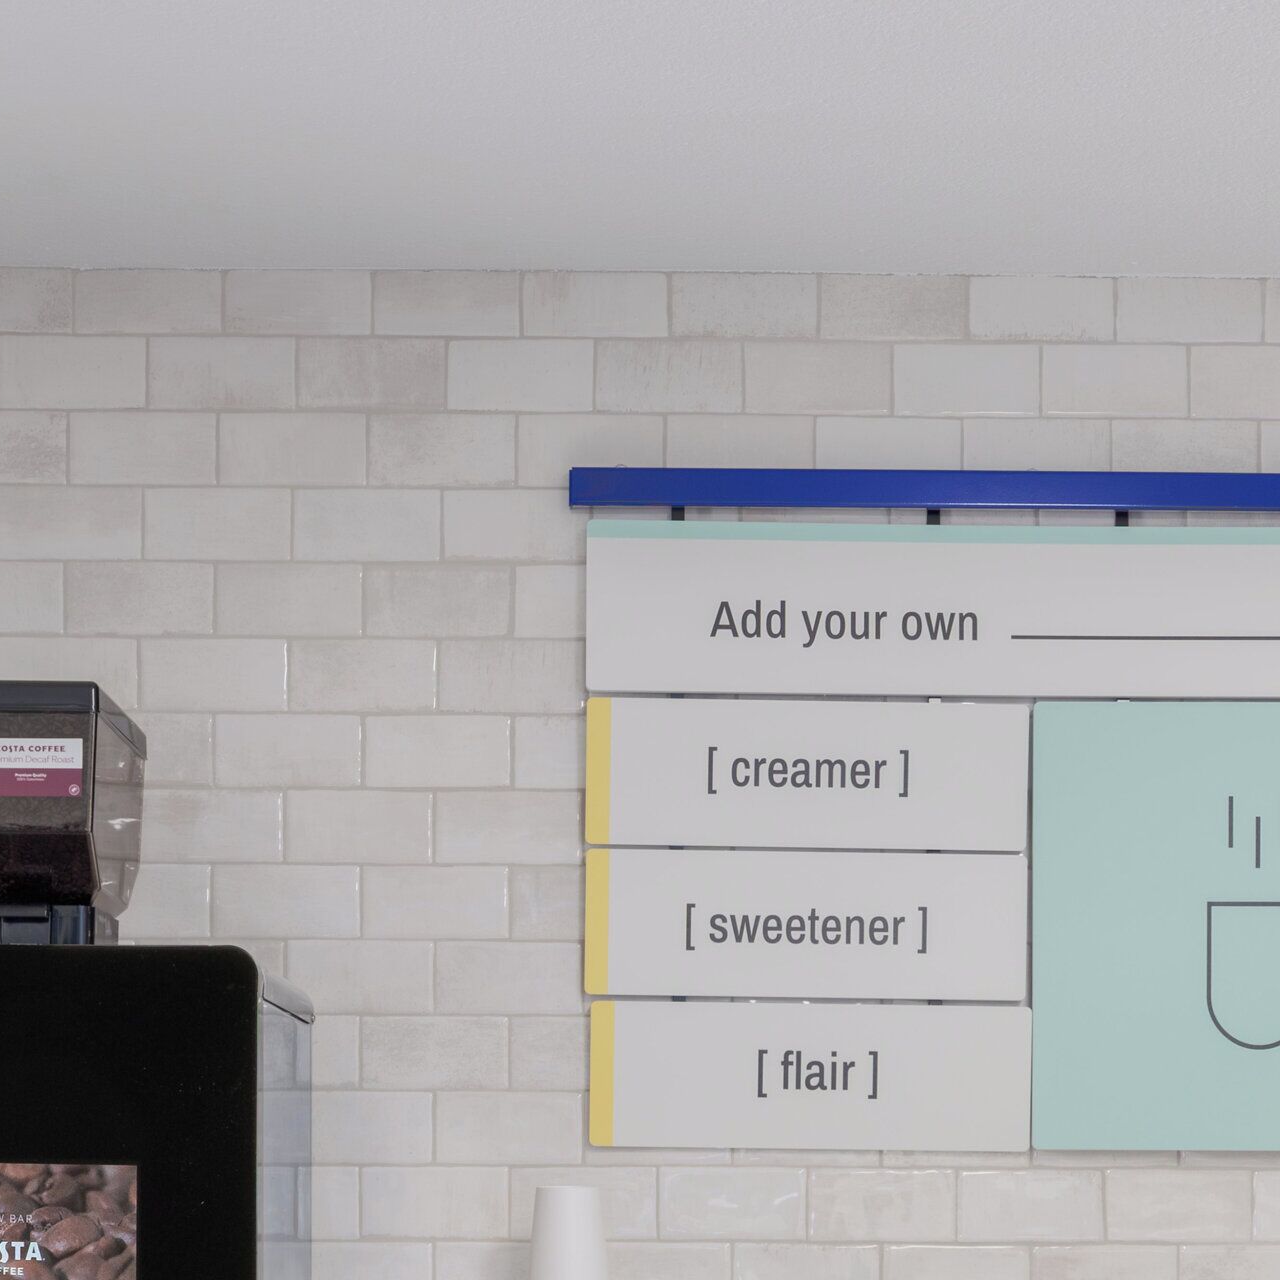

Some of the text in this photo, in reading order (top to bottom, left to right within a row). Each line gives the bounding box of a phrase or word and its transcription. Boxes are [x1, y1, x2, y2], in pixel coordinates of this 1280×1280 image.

[709, 599, 978, 648] Add your own
[28, 745, 66, 753] COFFEE
[25, 755, 50, 763] Decaf
[51, 755, 75, 763] Roast
[9, 1214, 33, 1223] BAR
